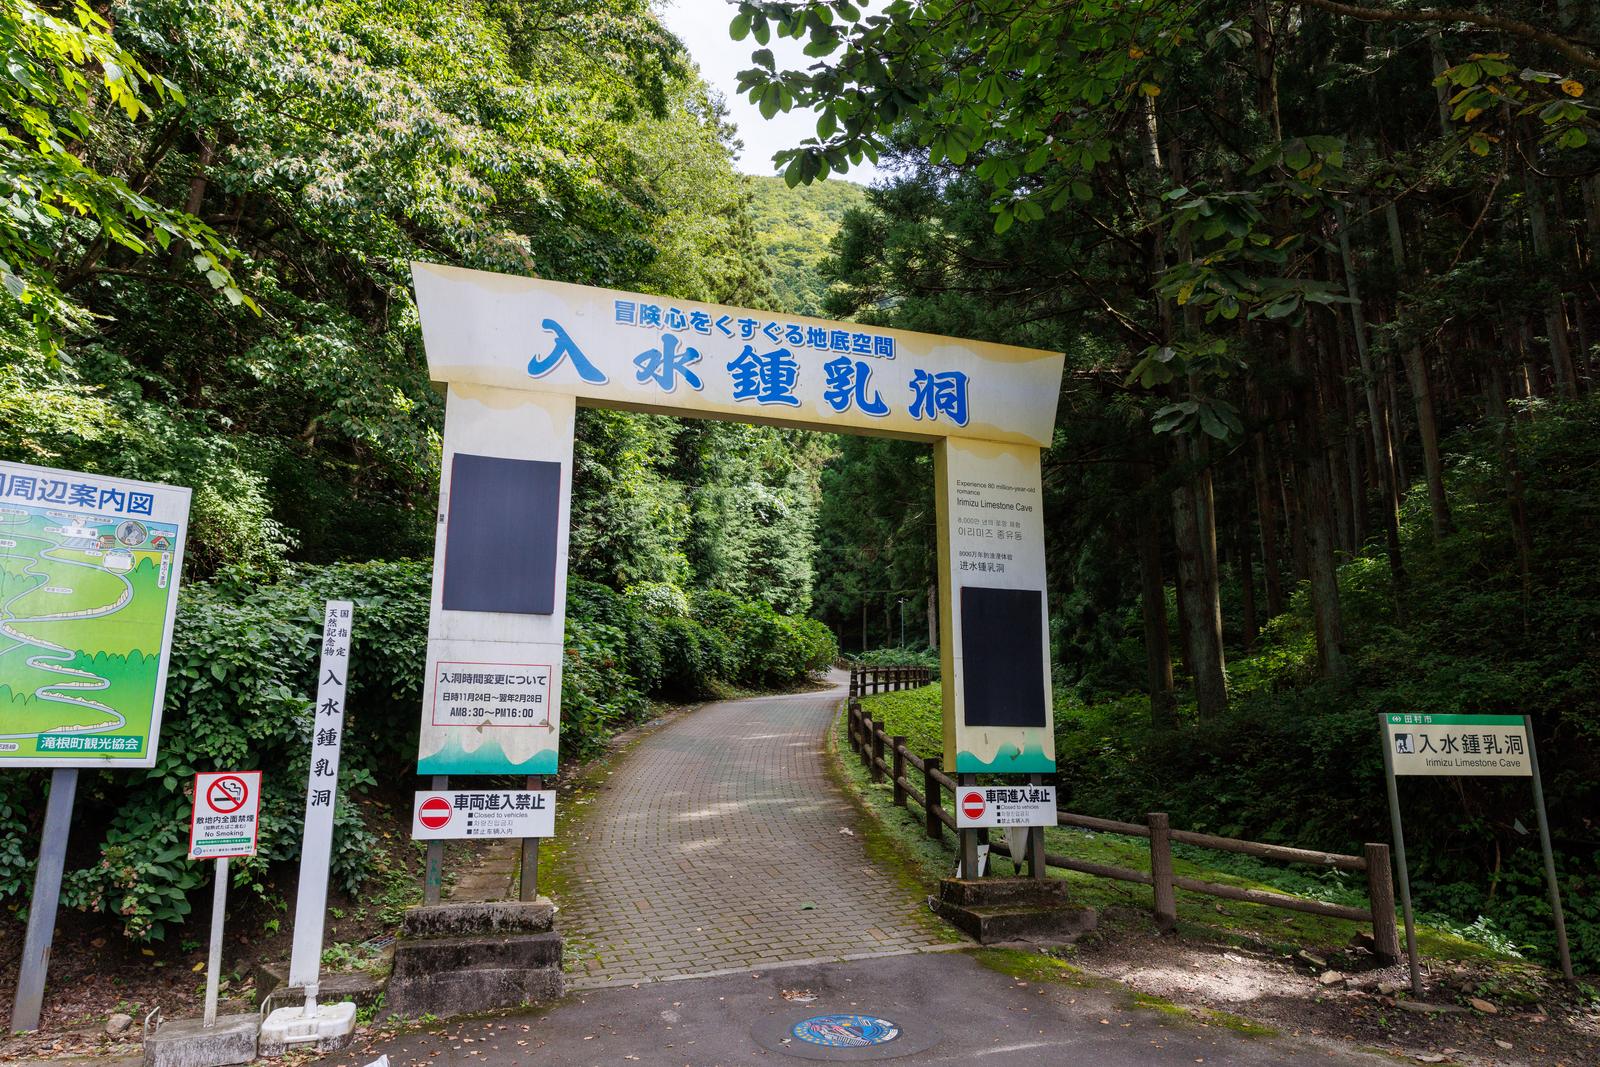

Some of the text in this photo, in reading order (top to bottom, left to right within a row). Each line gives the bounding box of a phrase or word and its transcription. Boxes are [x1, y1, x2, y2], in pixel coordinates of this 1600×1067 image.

[614, 299, 896, 359] 冒険心をくすぐる地底空間
[527, 318, 971, 428] 入水鍾乳洞
[956, 479, 987, 489] Experience
[996, 484, 1036, 493] million-year-old
[0, 473, 155, 516] 周辺案内図
[956, 497, 1033, 512] Irimizu Limestone Cave
[957, 526, 993, 538] 이리미즈
[324, 609, 338, 657] 天然記念物
[336, 609, 349, 657] 国指定
[440, 672, 547, 686] 入洞時間変更について
[1404, 715, 1432, 723] 田村市
[40, 736, 139, 750] 滝根町観光協会
[311, 669, 343, 807] 入水鍾乳洞
[1419, 733, 1524, 755] 入水鍾乳洞
[1426, 758, 1521, 767] Irimizu Limestone Cave
[453, 794, 545, 811] 車両進入禁止
[985, 789, 1051, 804] 車両進入禁止
[196, 814, 255, 824] 敷地内全面禁煙
